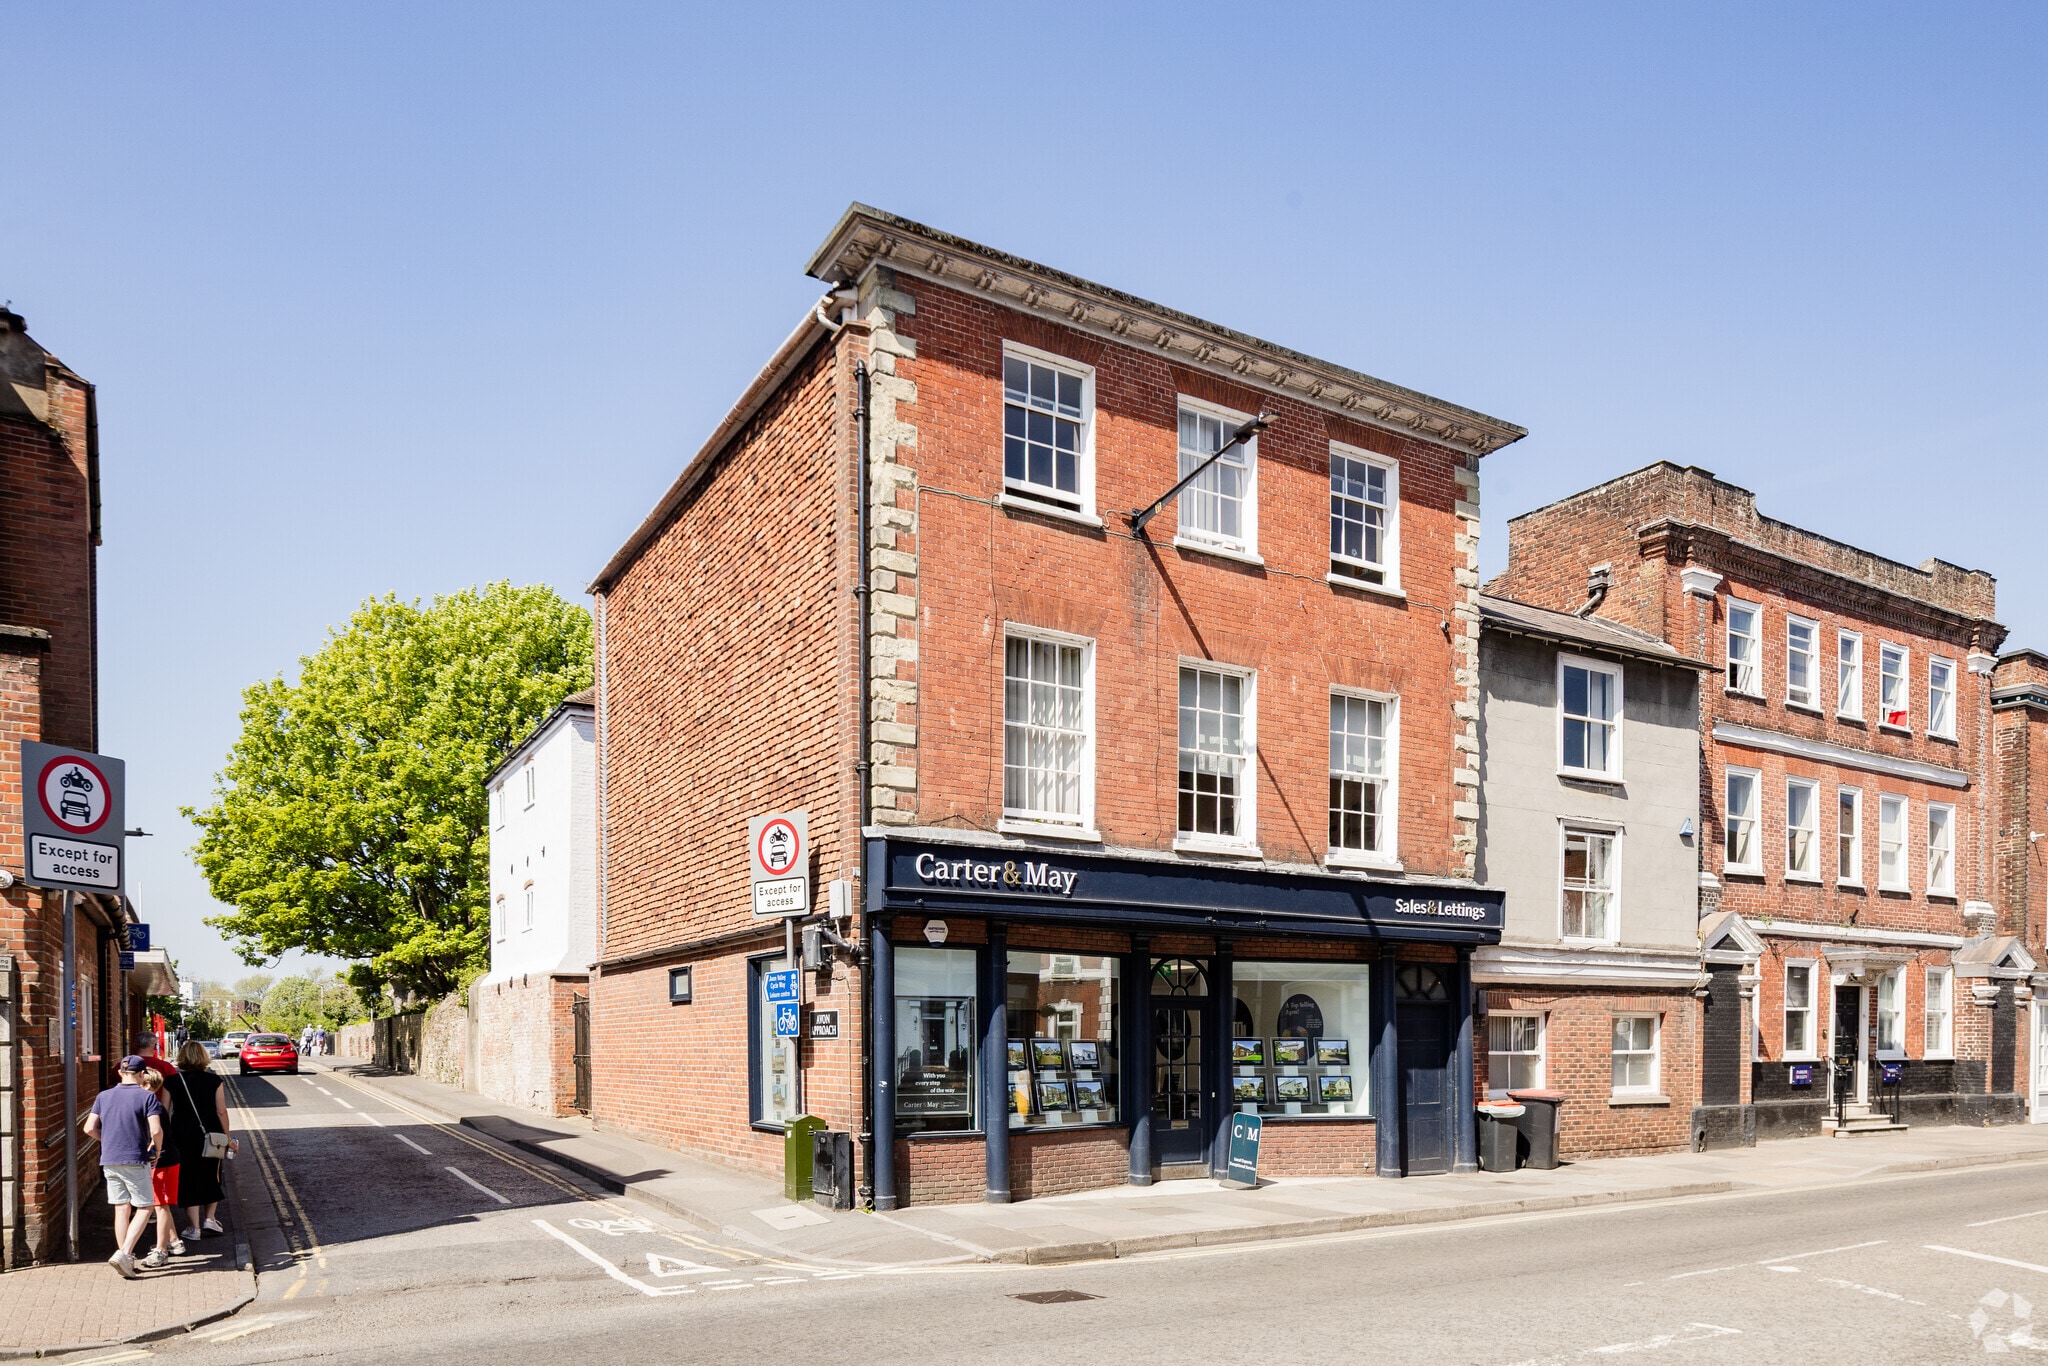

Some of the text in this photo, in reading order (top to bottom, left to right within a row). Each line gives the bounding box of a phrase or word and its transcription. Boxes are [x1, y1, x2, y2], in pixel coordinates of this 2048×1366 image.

[38, 842, 113, 864] Except for
[53, 863, 99, 878] access
[759, 883, 801, 896] Except for
[766, 897, 794, 907] access
